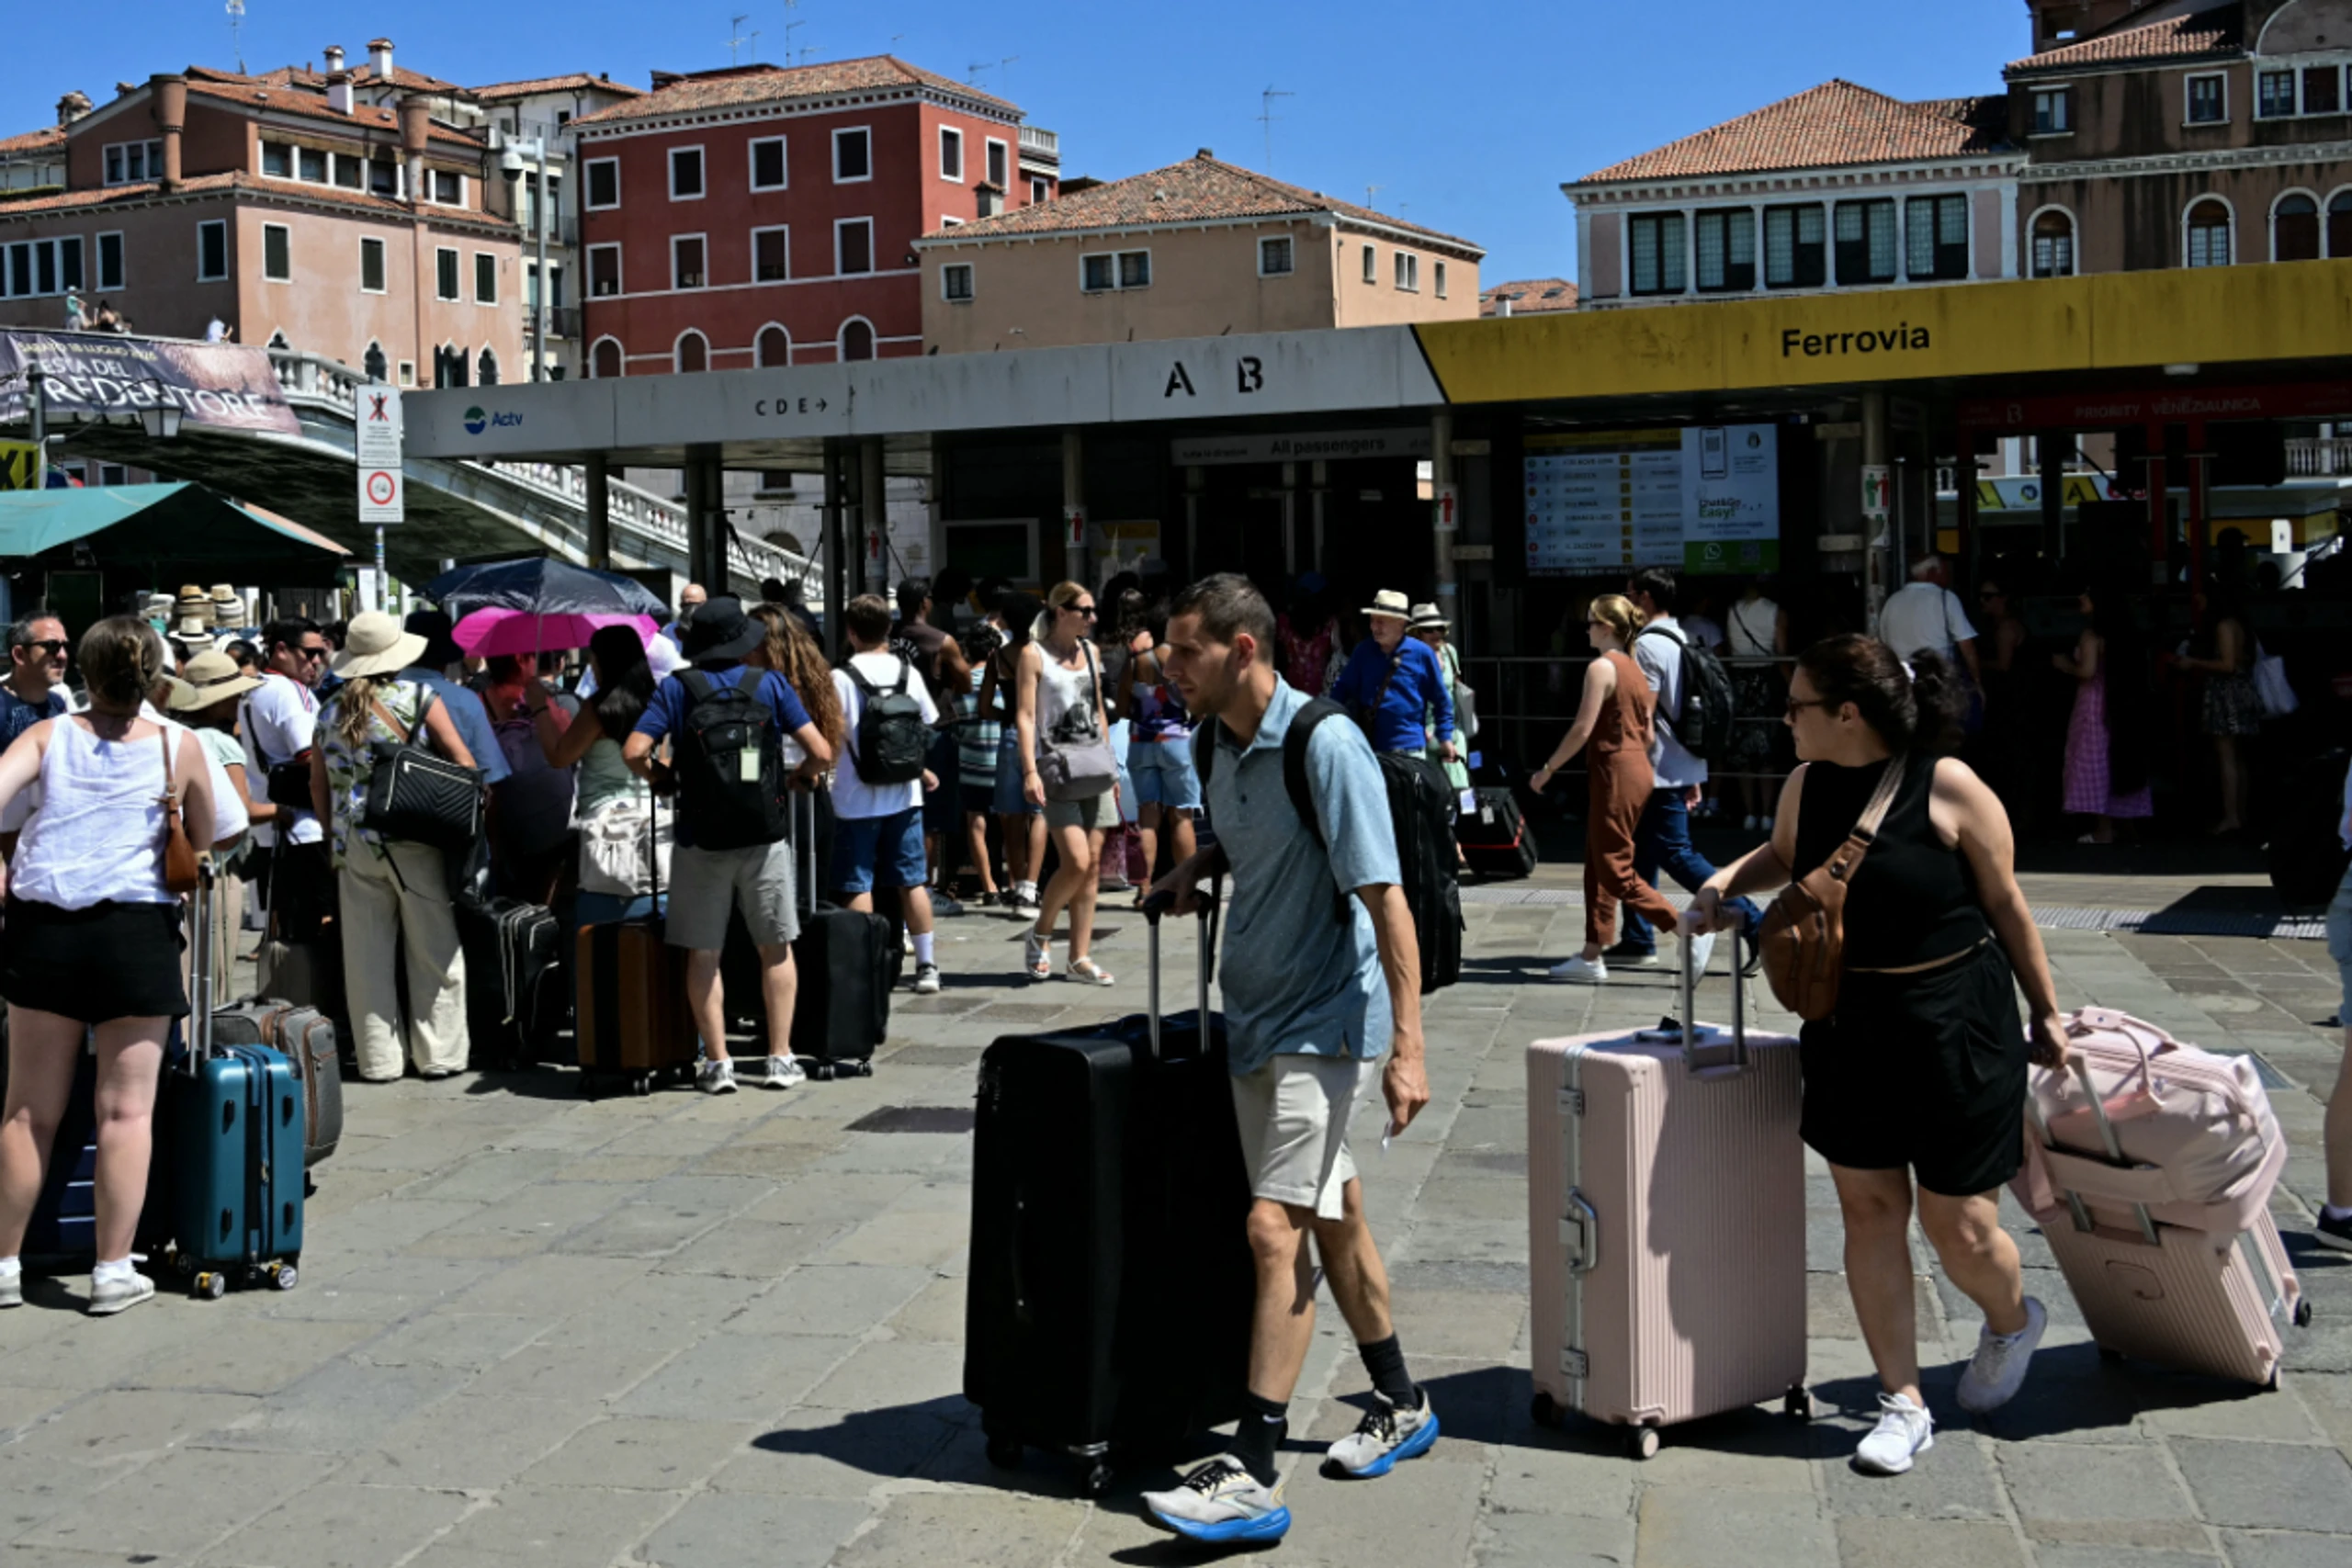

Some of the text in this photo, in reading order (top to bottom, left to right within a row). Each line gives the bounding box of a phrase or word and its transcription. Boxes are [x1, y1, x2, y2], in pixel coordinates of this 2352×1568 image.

[1781, 321, 1929, 357] Ferrovia
[83, 343, 129, 357] LUGLIO
[28, 358, 131, 378] ESTA DEL
[1164, 356, 1263, 398] A B
[44, 376, 271, 420] REDENTORE
[755, 398, 808, 416] C D E
[492, 412, 523, 427] Actv
[2074, 402, 2141, 420] PRIORITY
[1271, 436, 1385, 457] All passengers
